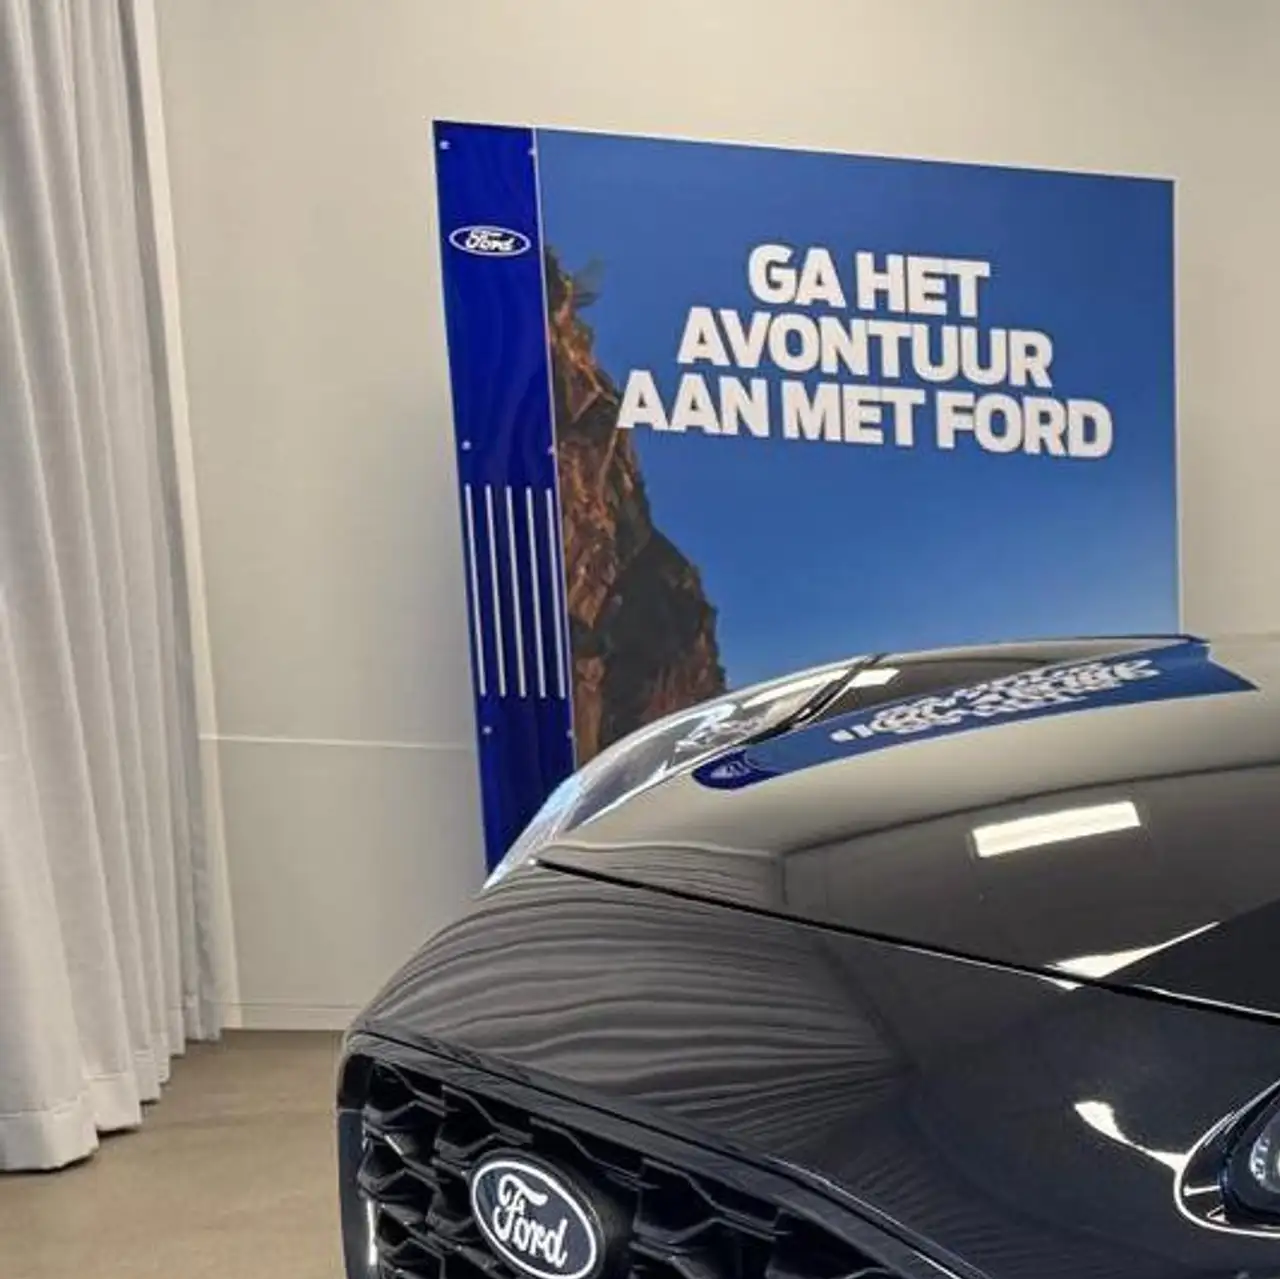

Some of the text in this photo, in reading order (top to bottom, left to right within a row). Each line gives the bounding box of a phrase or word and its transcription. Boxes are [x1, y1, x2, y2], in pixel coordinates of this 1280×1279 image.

[465, 230, 515, 252] Ford
[748, 243, 991, 318] GA HET
[677, 306, 1053, 388] AVONTUUR
[616, 369, 1114, 458] AAN MET FORD
[492, 1173, 568, 1268] Ford
